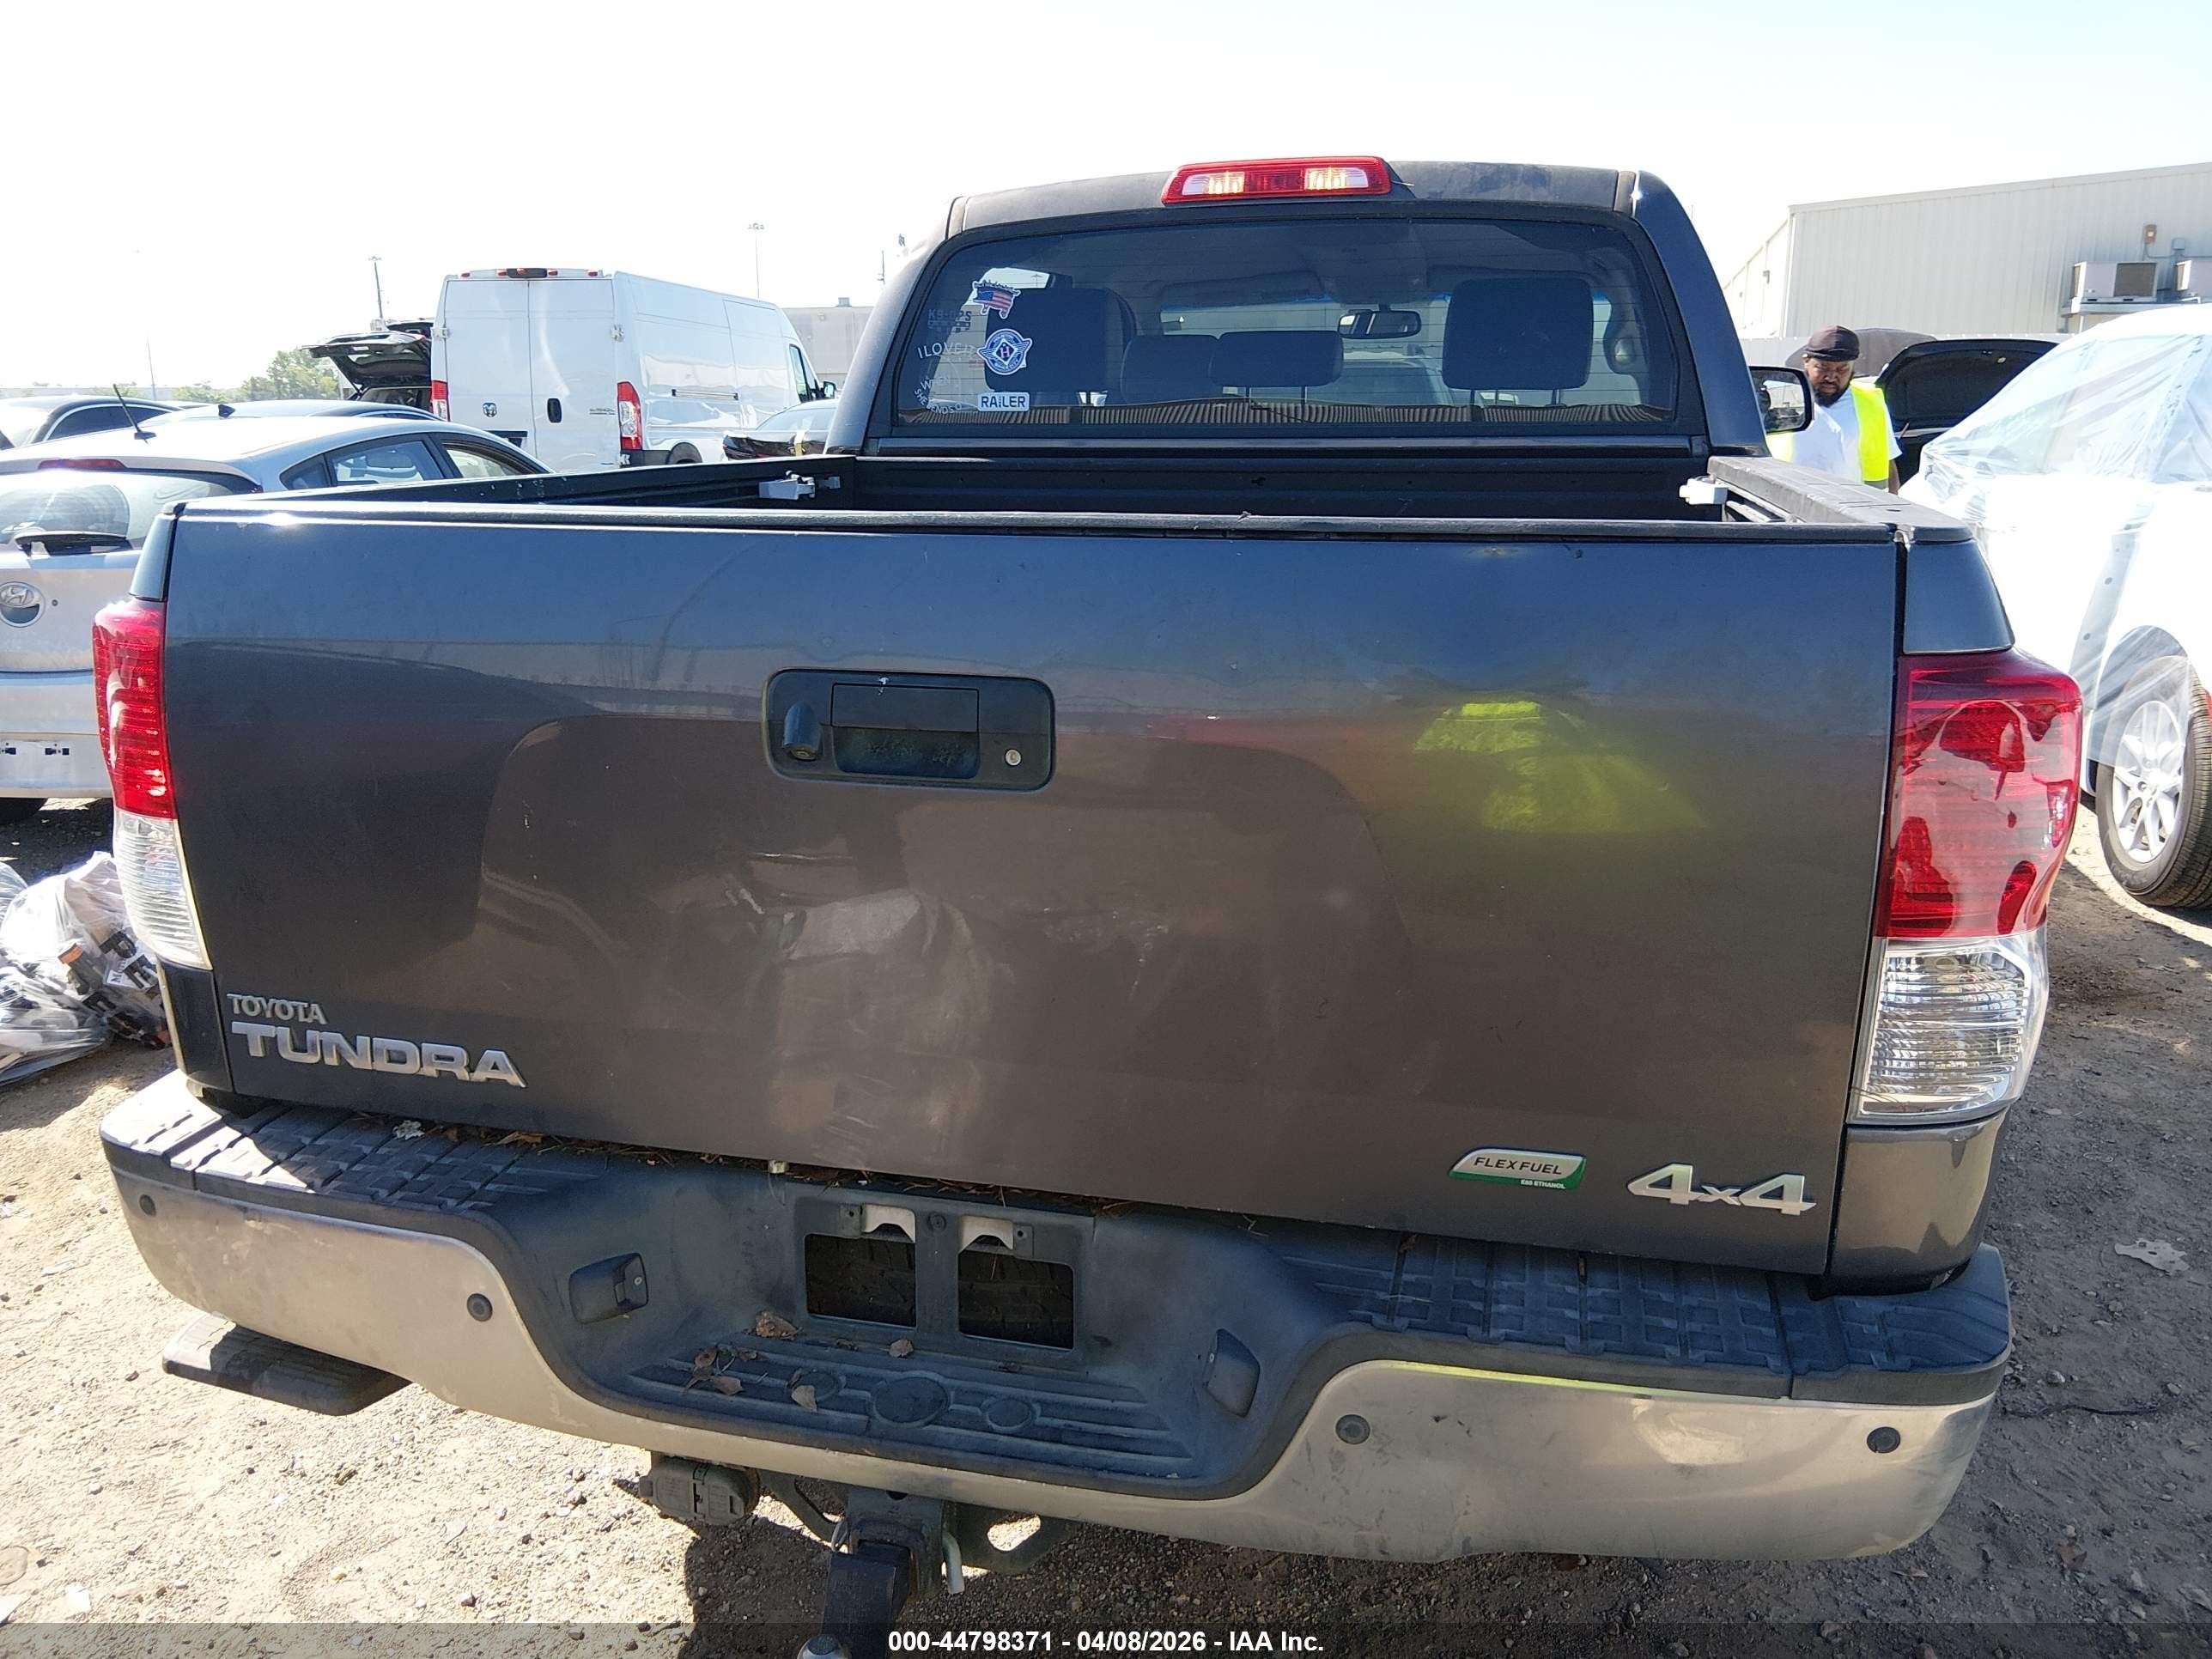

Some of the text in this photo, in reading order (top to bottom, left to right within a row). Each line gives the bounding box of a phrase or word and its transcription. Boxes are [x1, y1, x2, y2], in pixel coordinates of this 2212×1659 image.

[226, 993, 328, 1024] TOYOTA
[231, 1021, 527, 1088] TUNDRA
[1534, 1181, 1566, 1189] ETHANOL
